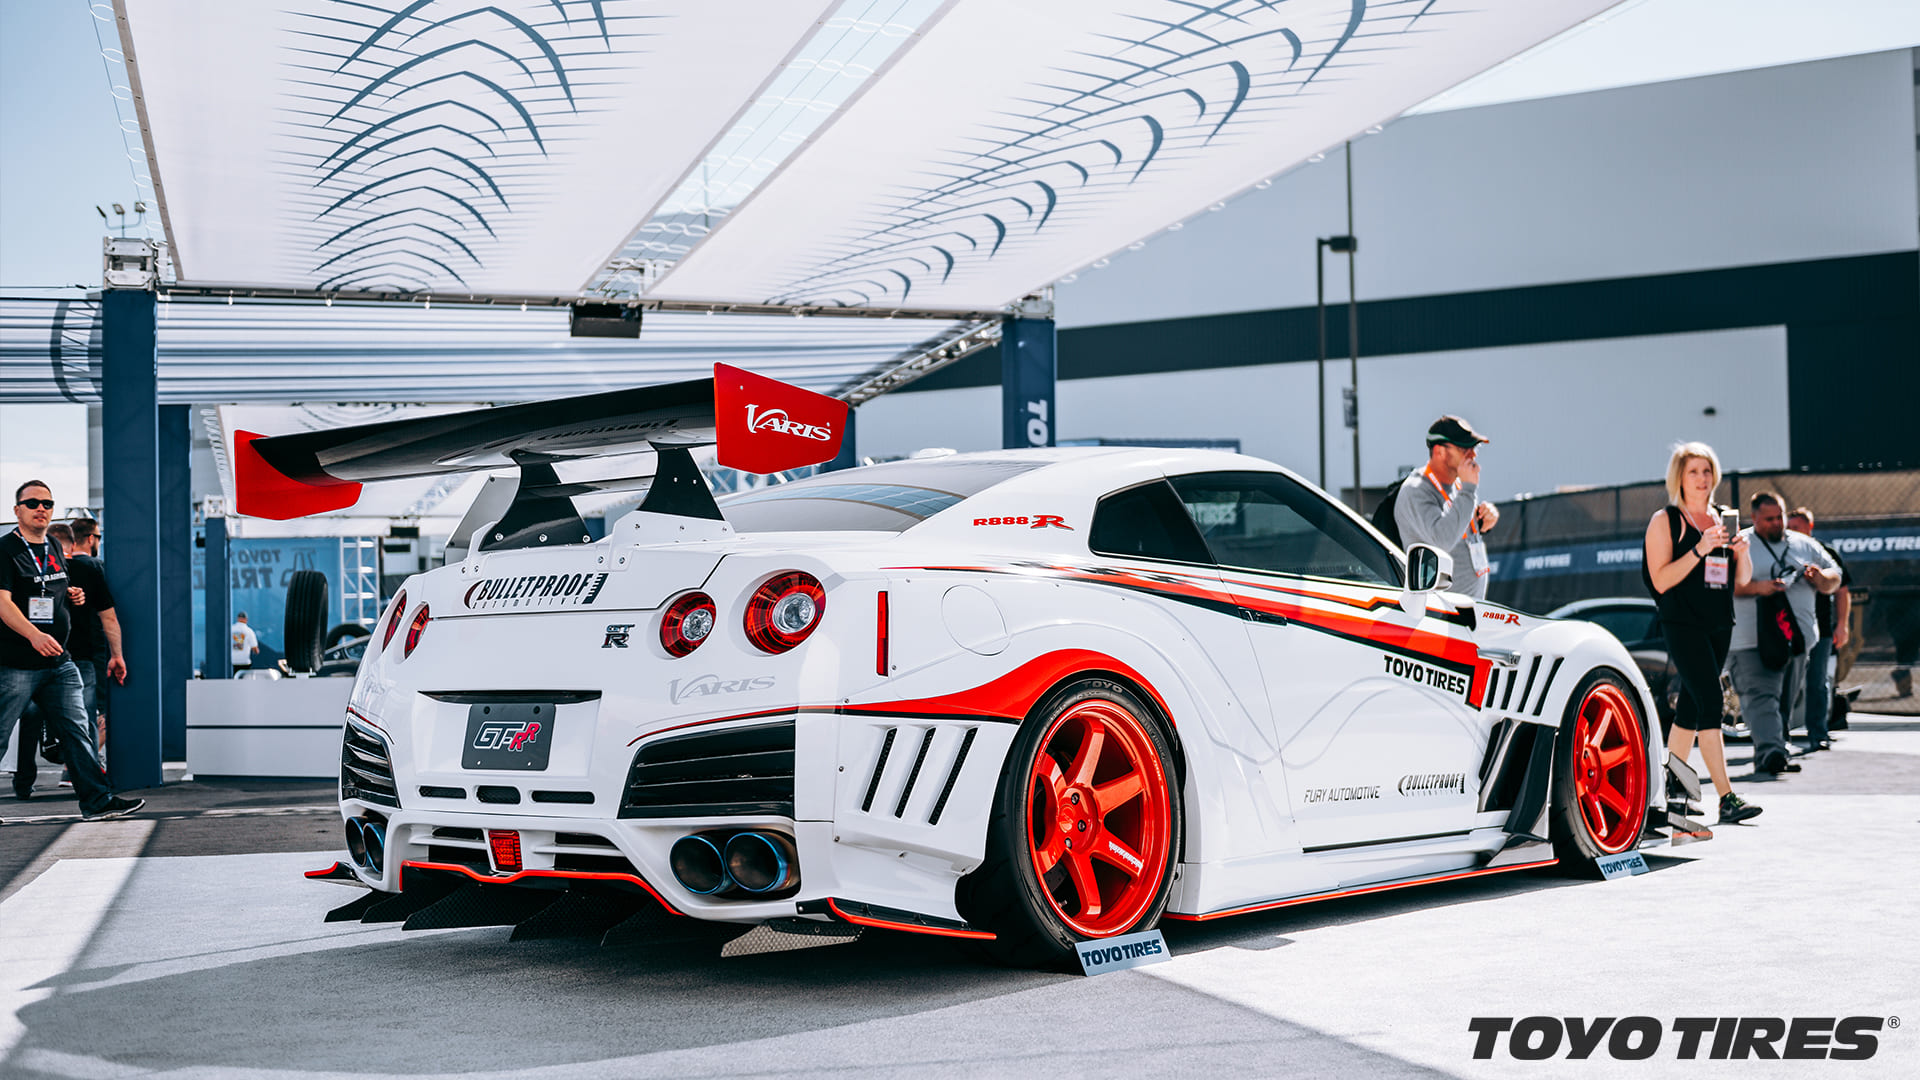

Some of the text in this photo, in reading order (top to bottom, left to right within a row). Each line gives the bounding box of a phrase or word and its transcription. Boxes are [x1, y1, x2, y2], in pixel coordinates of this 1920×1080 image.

[745, 404, 832, 441] VARIS
[1028, 399, 1048, 447] TO
[1832, 536, 1920, 553] TOYO TIR
[475, 573, 594, 601] BULLETPROOF
[1082, 680, 1123, 693] TOYO
[1384, 654, 1466, 695] TOYO TIRES
[669, 674, 776, 705] VARIS
[1303, 785, 1381, 803] FURY AUTOMOTIVE
[1405, 774, 1460, 790] BULLETPROOF
[1601, 860, 1623, 874] TOYO
[1081, 939, 1162, 967] TOYO TIRES
